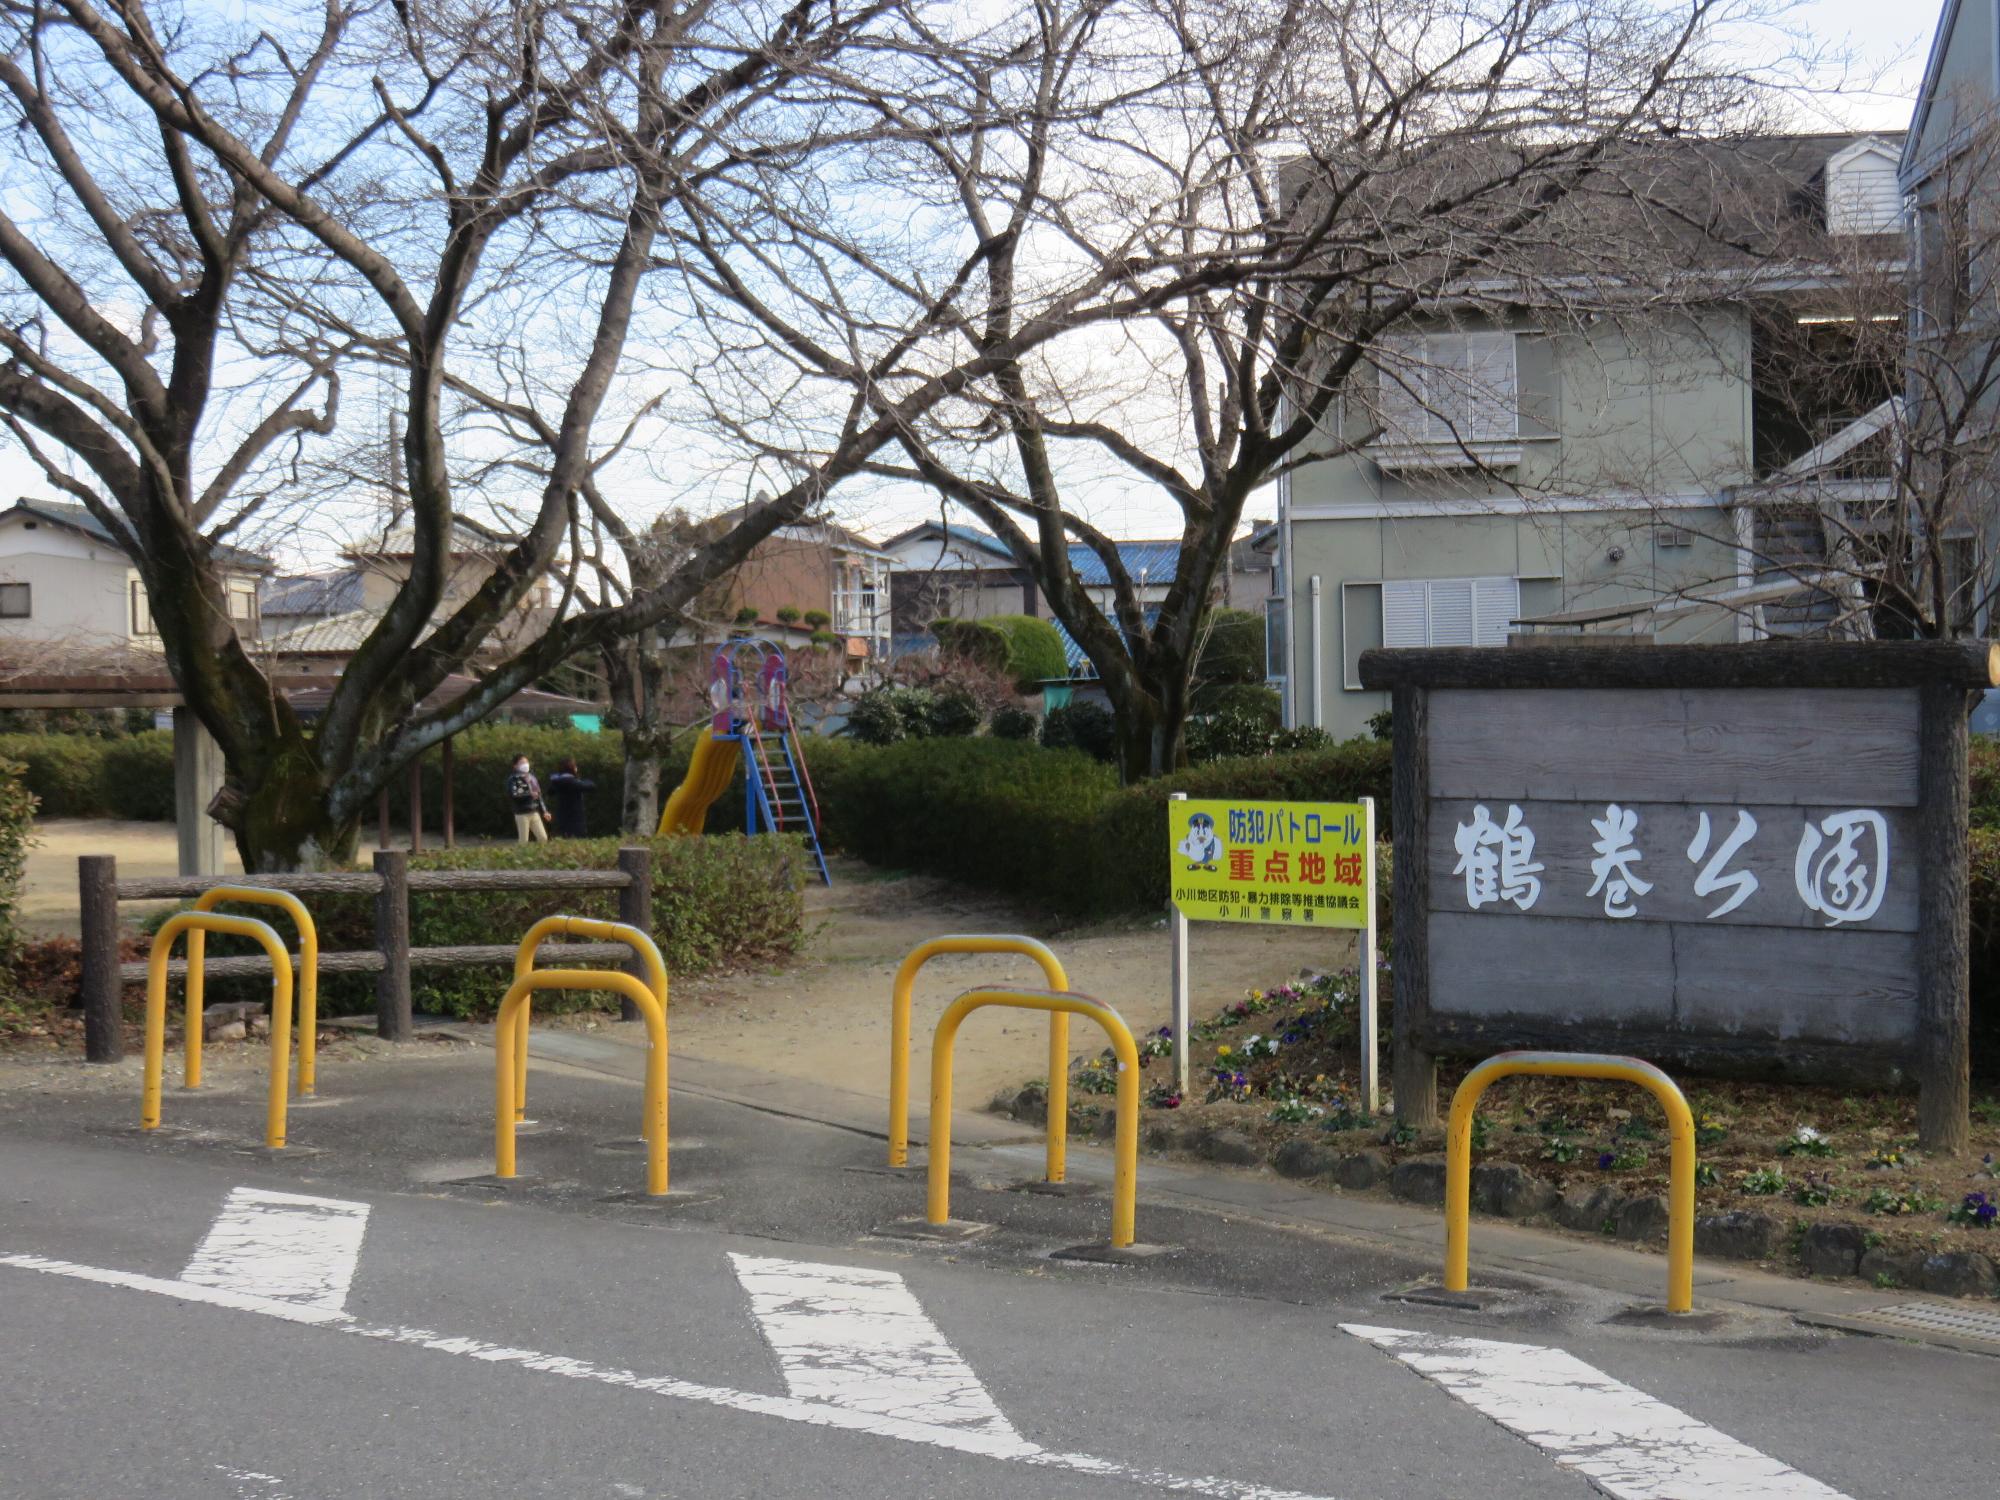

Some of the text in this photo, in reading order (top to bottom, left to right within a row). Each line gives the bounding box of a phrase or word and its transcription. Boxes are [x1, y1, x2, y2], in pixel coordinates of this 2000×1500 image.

[1228, 808, 1361, 846] 防犯パトロール
[1228, 849, 1362, 887] 重点地域
